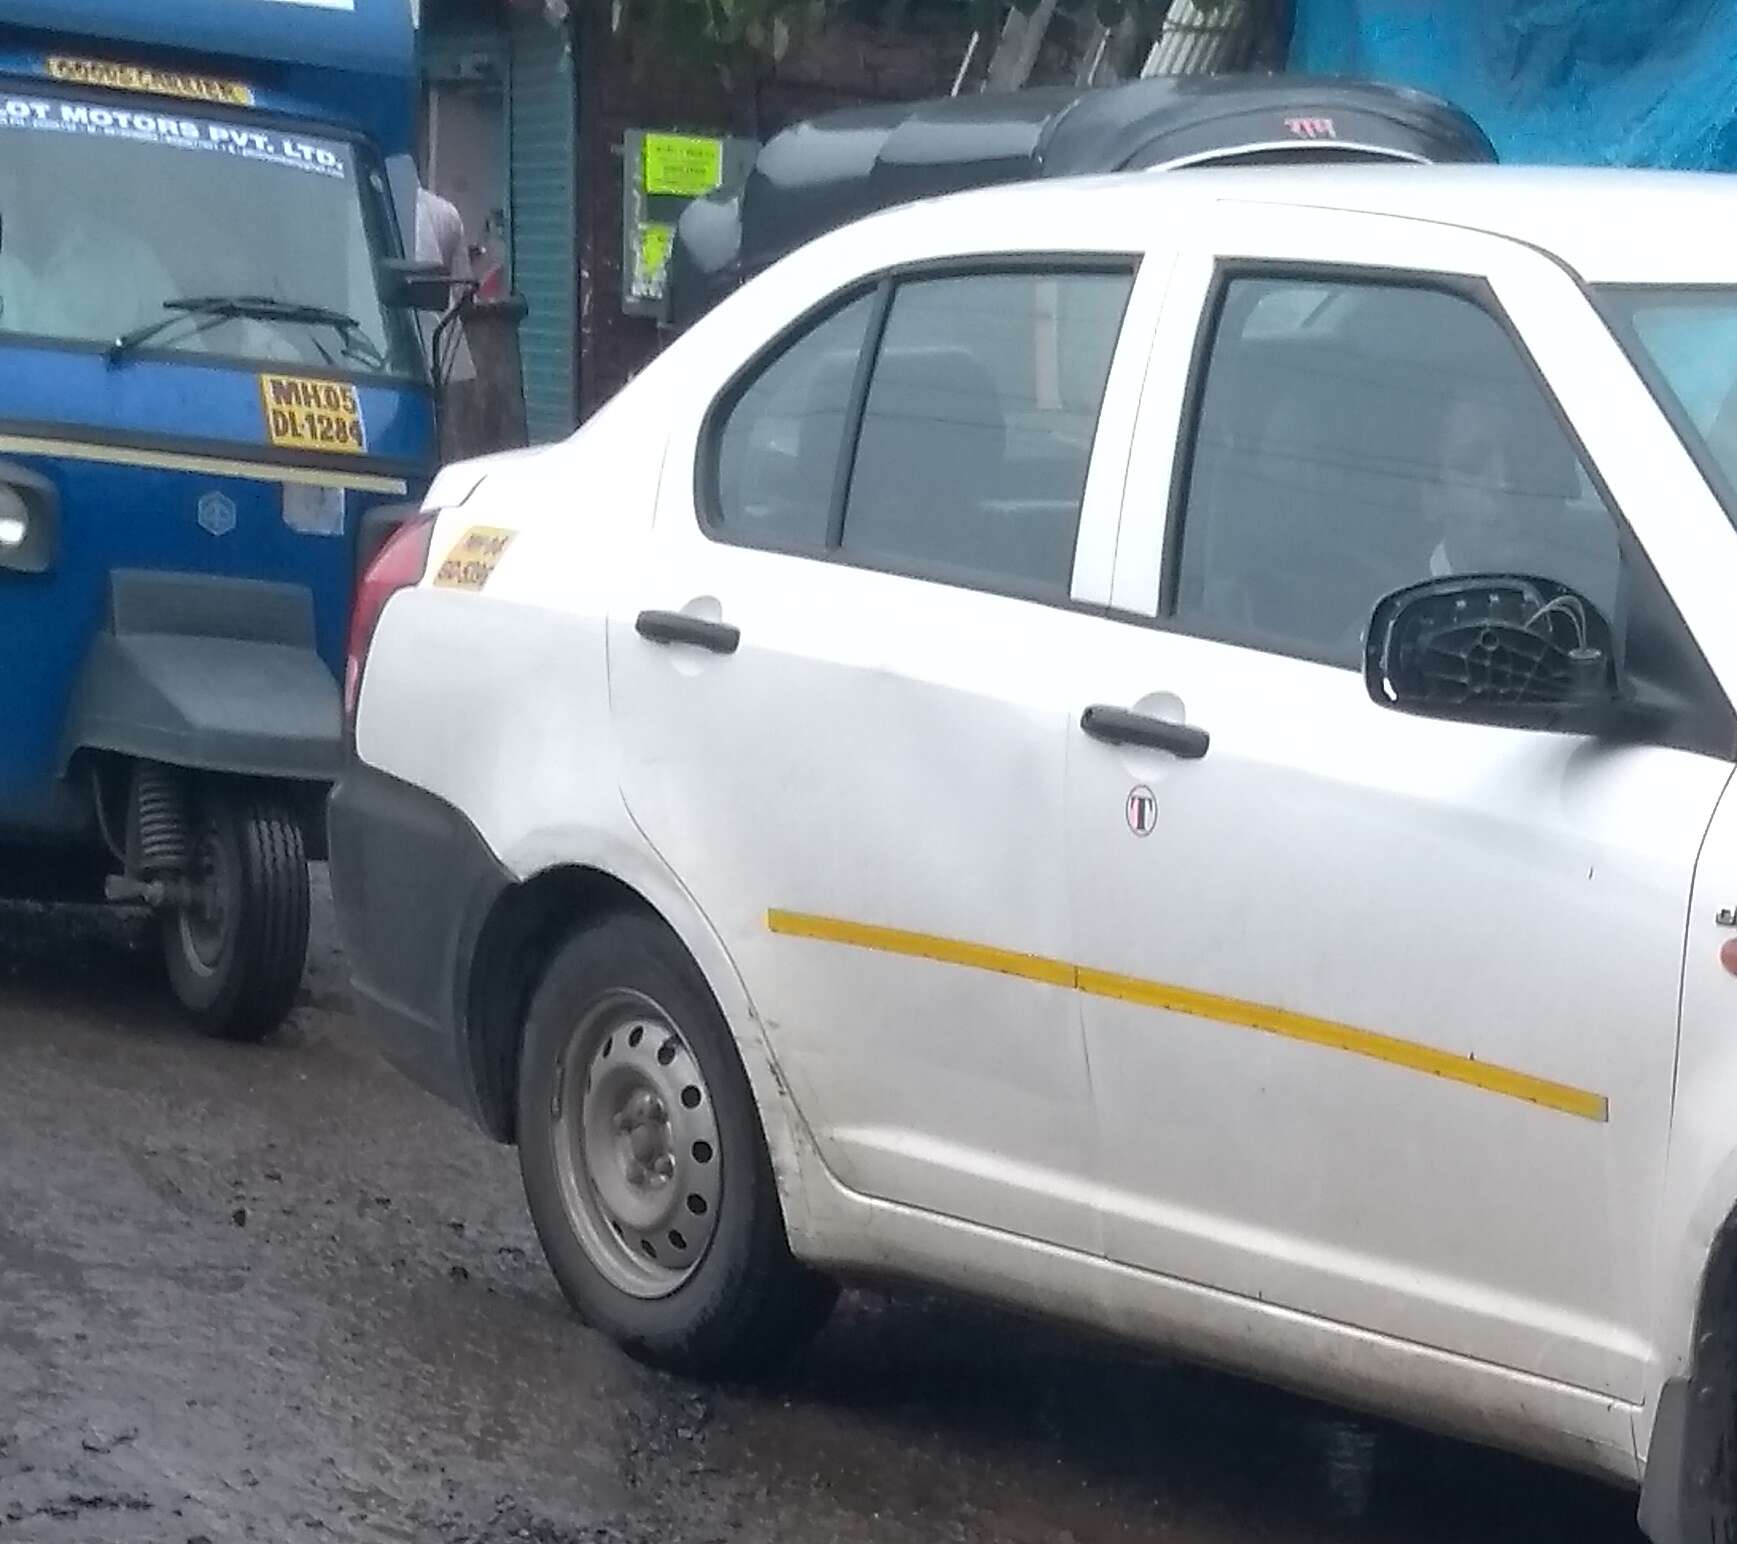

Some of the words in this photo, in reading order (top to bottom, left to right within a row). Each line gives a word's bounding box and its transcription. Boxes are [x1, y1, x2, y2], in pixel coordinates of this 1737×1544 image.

[0, 101, 51, 120] OT
[60, 104, 200, 138] MOTORS
[209, 126, 275, 153] PVT.
[282, 139, 344, 170] LTD.
